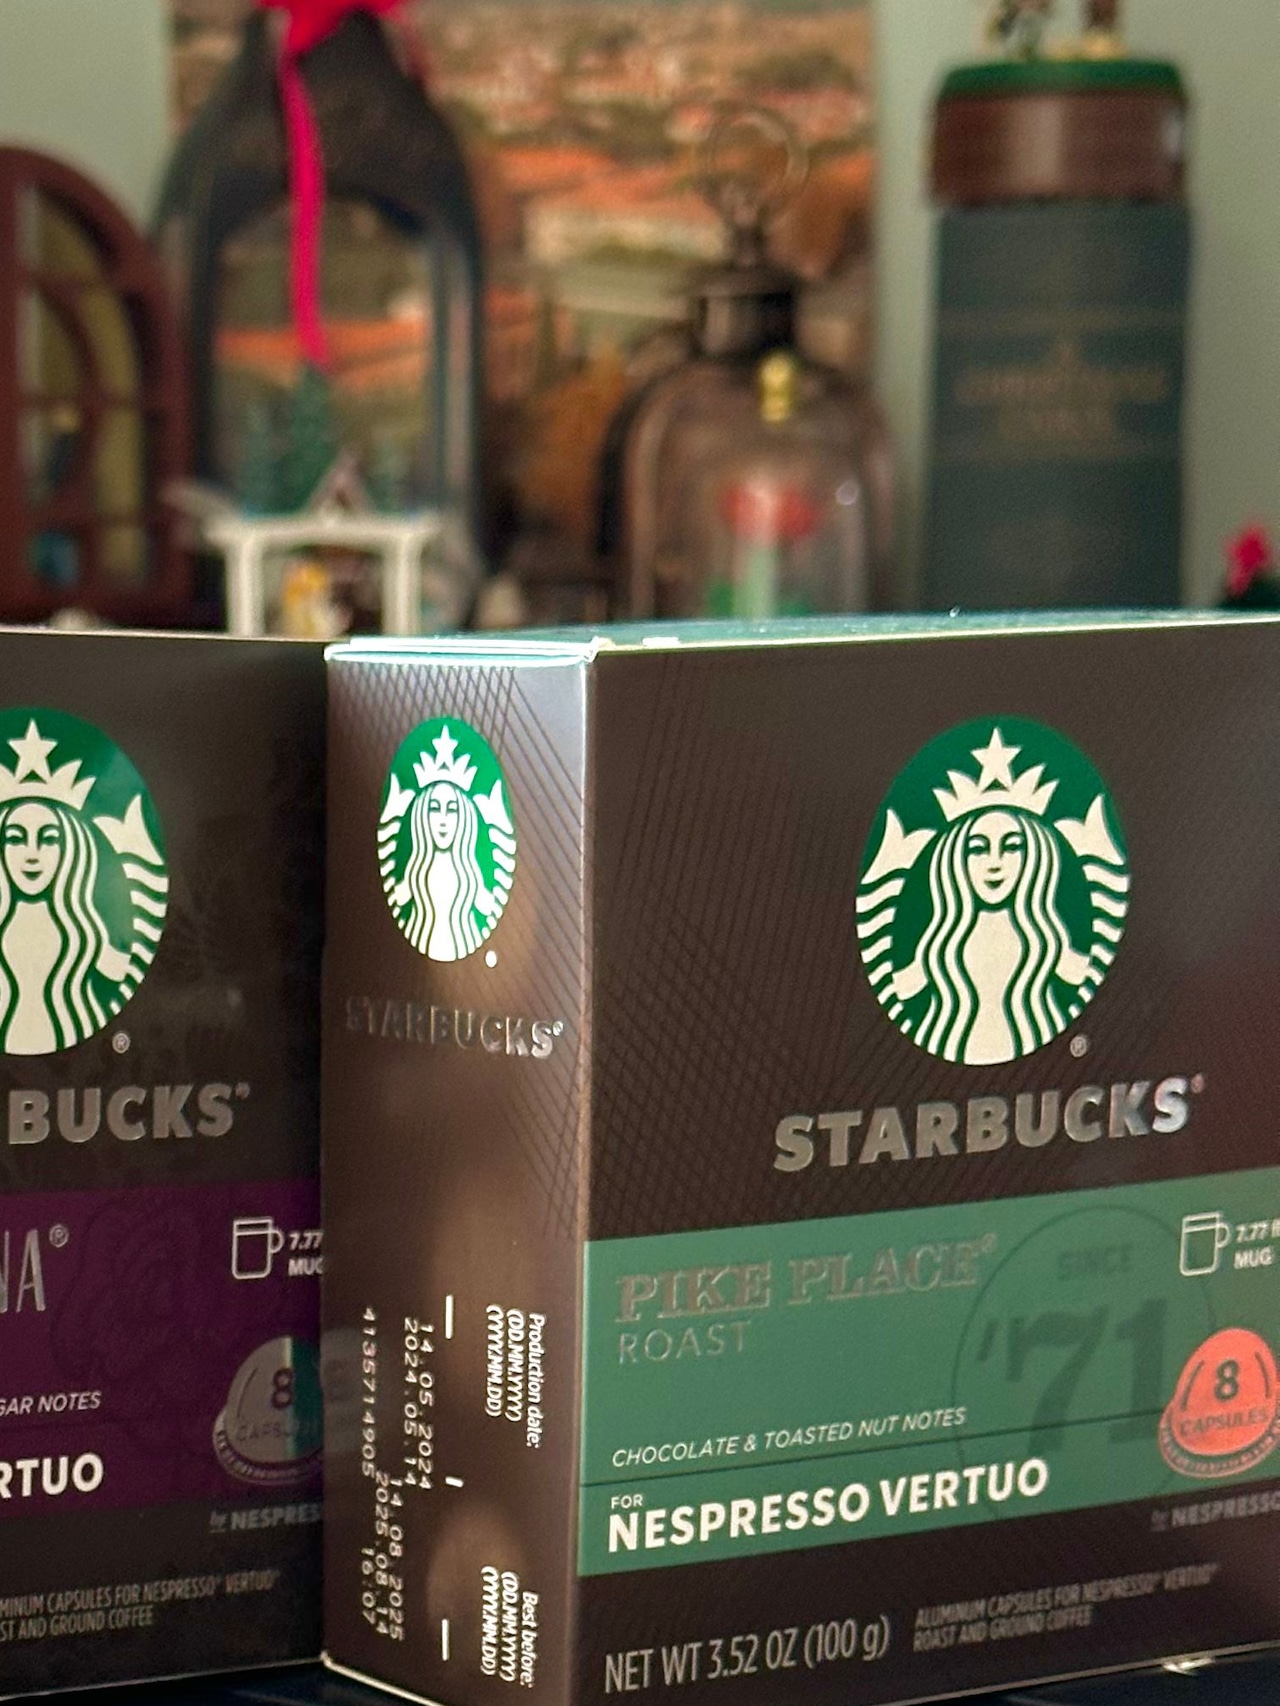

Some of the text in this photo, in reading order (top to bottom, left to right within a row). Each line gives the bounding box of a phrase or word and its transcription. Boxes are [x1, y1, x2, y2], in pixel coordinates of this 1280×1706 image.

[1233, 1248, 1273, 1270] MUG
[615, 1260, 772, 1323] PIKE
[484, 1303, 504, 1418] (YYYY.MM.DD)
[504, 1308, 525, 1422] (DD.MM.YYYY)
[619, 1320, 751, 1364] ROAST
[38, 1390, 102, 1415] NOTES
[273, 1368, 293, 1409] 8
[525, 1313, 547, 1449] Production date:
[1214, 1360, 1239, 1401] 8
[612, 1406, 967, 1468] CHOCOLATE & TOASTED NUT NOTES
[231, 1503, 320, 1530] NESPRES
[607, 1458, 1049, 1553] NESPRESSO VERTUO
[610, 1494, 643, 1510] FOR
[18, 1617, 48, 1640] AND
[50, 1611, 107, 1636] GROUND
[108, 1604, 154, 1629] COFFEE
[47, 1585, 112, 1613] CAPSULES
[115, 1583, 143, 1605] FOR
[479, 1565, 499, 1675] (YYYY.MM.DD)
[499, 1571, 518, 1682] (DD.MM.YYYY)
[518, 1591, 539, 1689] Best before:
[605, 1615, 892, 1694] NET WT 3.52 OZ (100 g)
